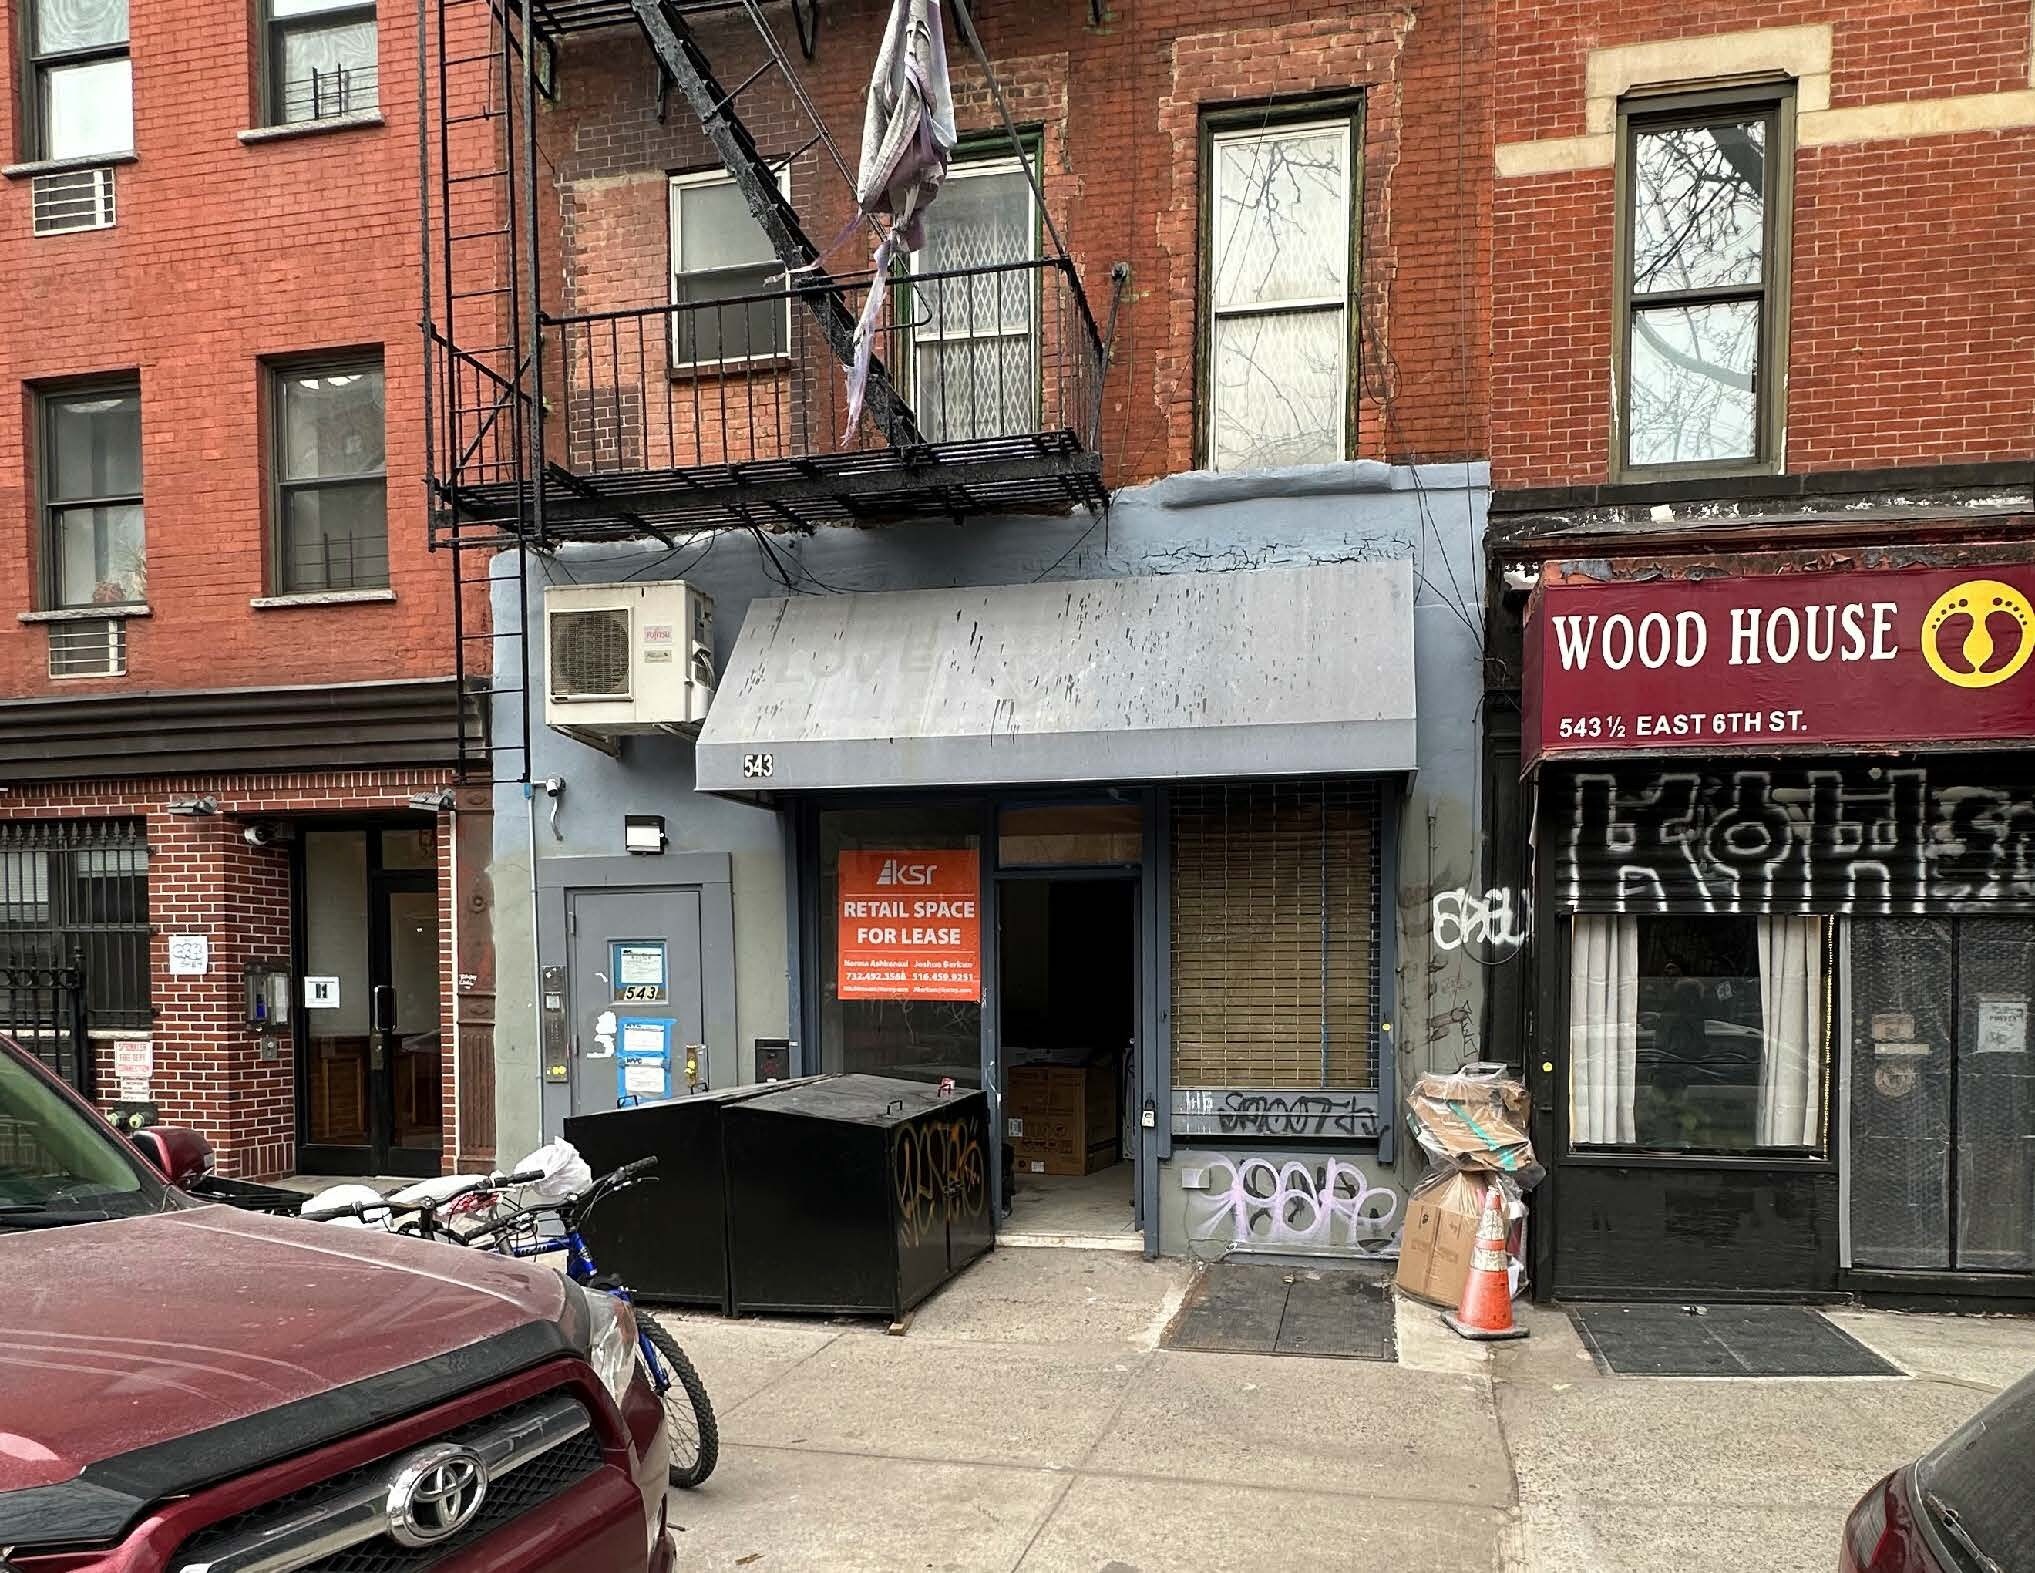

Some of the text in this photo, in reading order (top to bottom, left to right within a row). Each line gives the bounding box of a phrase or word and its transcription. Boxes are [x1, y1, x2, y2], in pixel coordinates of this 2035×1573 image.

[1552, 602, 1899, 671] WOOD HOUSE
[1559, 718, 1602, 738] 543
[1636, 713, 1706, 736] EAST
[1712, 711, 1761, 734] 6TH
[1768, 710, 1807, 732] ST.
[744, 754, 773, 778] 543
[844, 901, 975, 918] RETAIL SPACE
[857, 928, 961, 945] FOR LEASE
[626, 986, 656, 1000] 543
